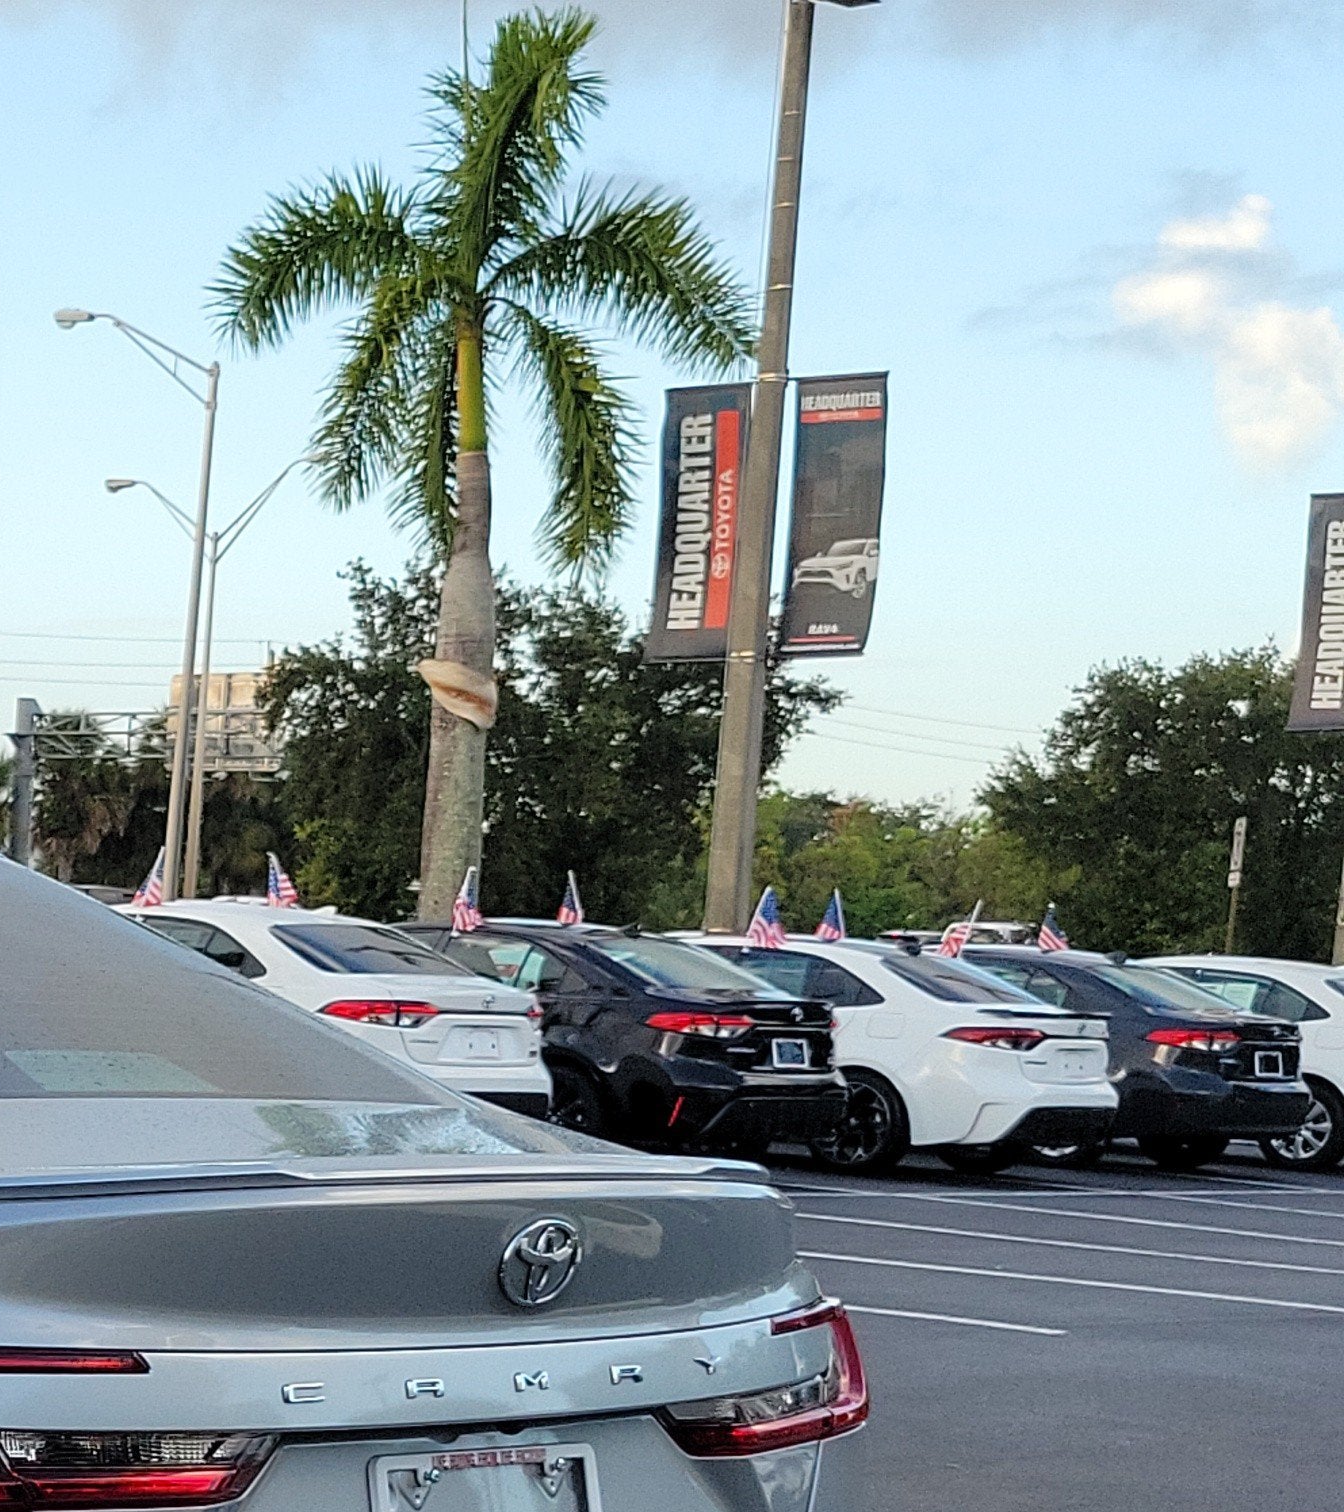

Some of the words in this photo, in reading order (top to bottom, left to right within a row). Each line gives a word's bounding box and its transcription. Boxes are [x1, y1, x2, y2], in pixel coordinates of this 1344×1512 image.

[666, 412, 713, 631] HEADQUARTER
[713, 468, 737, 552] TOYOTA
[282, 1356, 721, 1403] CAMRY
